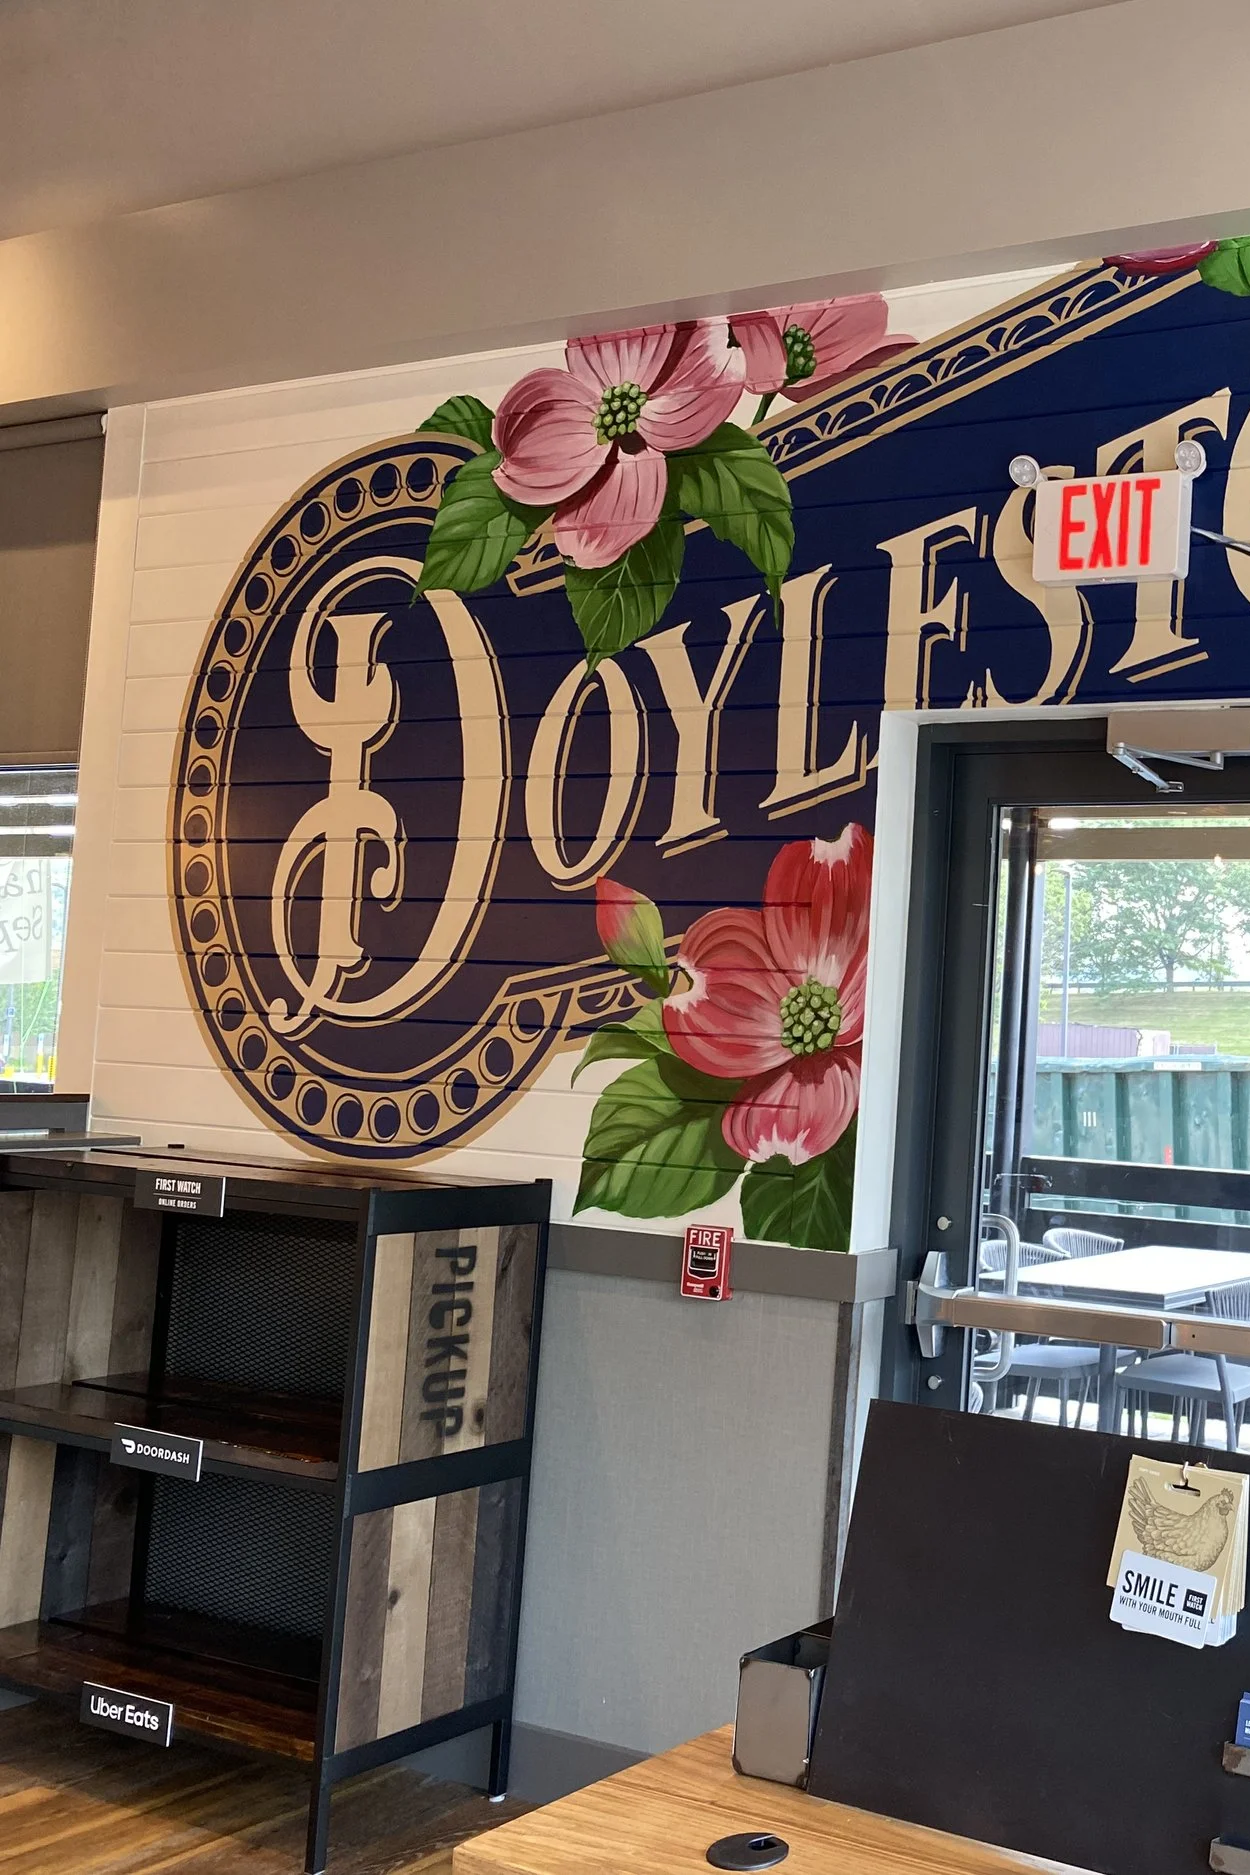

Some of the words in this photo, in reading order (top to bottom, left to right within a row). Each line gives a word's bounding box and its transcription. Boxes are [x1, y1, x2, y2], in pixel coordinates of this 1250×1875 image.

[1058, 478, 1161, 571] EXIT
[155, 1178, 176, 1192] FIRST
[177, 1180, 201, 1194] WATCH
[158, 1198, 176, 1207] ONLINE
[177, 1200, 197, 1210] ORDERS
[689, 1229, 721, 1247] FIRE
[419, 1245, 477, 1438] PICKUP
[136, 1443, 190, 1465] DOORDASH
[1122, 1569, 1178, 1608] SMILE
[1189, 1594, 1204, 1604] FIRST
[1119, 1595, 1137, 1609] WITH
[1138, 1601, 1157, 1616] YOUR
[1158, 1607, 1183, 1624] MOUTH
[1184, 1616, 1201, 1630] FULL
[1186, 1601, 1203, 1611] WATCH
[90, 1695, 124, 1720] Uber
[124, 1704, 159, 1731] Eats
